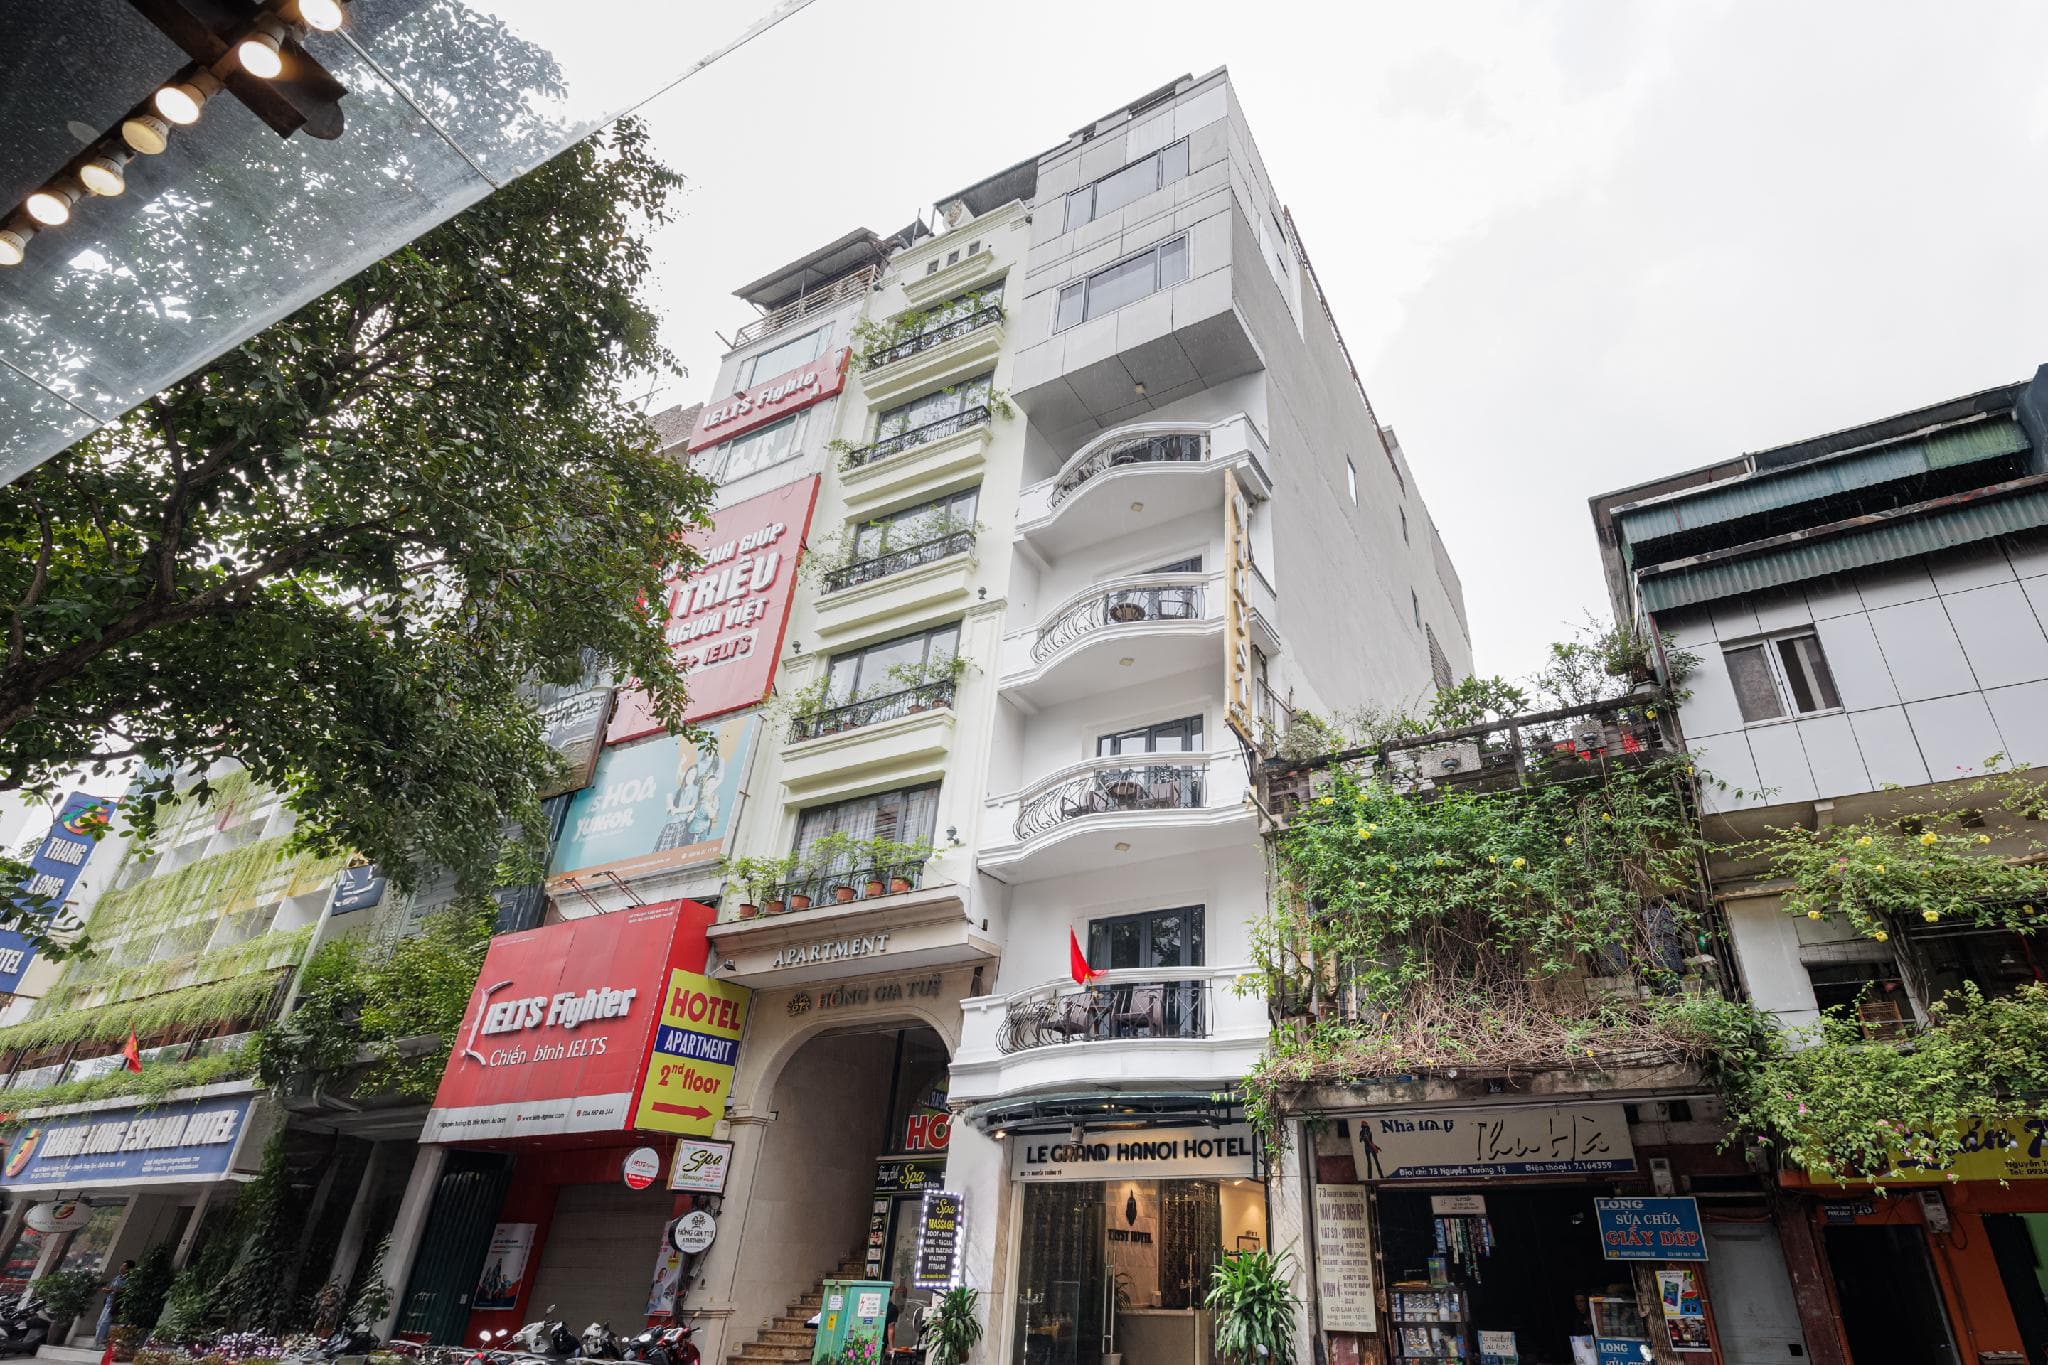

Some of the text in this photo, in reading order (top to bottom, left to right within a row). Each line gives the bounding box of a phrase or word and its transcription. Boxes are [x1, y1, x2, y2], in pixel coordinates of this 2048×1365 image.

[676, 552, 783, 619] TRIỆU
[725, 598, 769, 629] VIỆT
[703, 636, 752, 665] IELTS
[44, 836, 88, 867] THANG
[27, 872, 65, 900] LONG
[773, 934, 890, 968] APARTMENT
[481, 987, 637, 1035] IELTS Fighter
[669, 986, 741, 1031] HOTEL
[490, 1044, 527, 1067] Chiến
[566, 1037, 609, 1059] IELTS
[664, 1029, 733, 1062] APARTMENT
[658, 1063, 721, 1094] 2nd floor
[1380, 1118, 1415, 1133] Nhà
[682, 1149, 723, 1173] Spa
[1027, 1137, 1253, 1164] LE GRAND HANOI HOTEL
[899, 1163, 927, 1190] Spa
[936, 1199, 956, 1218] Spa
[1600, 1200, 1645, 1209] LONG
[1615, 1211, 1681, 1225] SỬA CHỮA
[1660, 1227, 1699, 1246] DÉP
[1600, 1342, 1628, 1353] LONG
